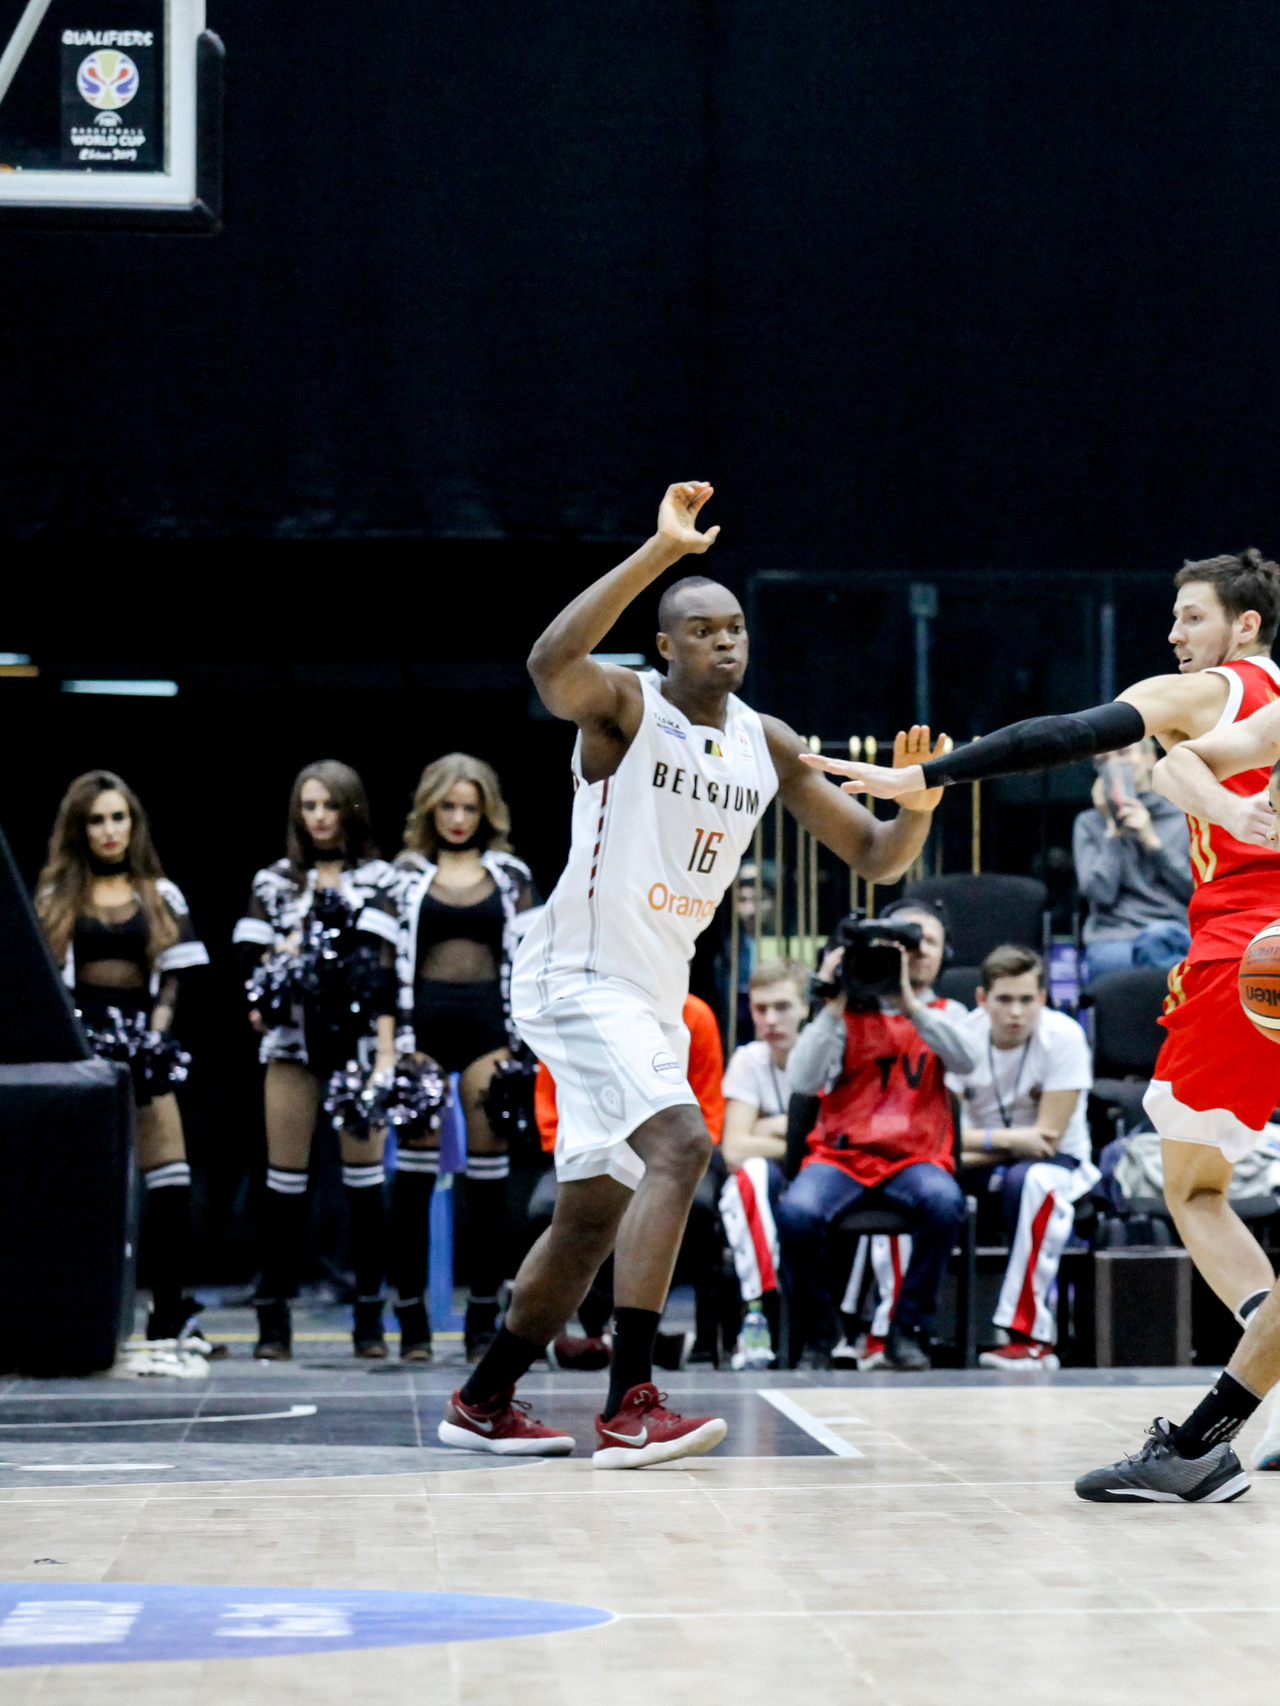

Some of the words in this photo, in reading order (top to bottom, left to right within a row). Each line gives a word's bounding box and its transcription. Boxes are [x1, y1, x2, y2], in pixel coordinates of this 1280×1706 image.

[62, 30, 153, 46] QUALIFIERS
[71, 135, 117, 146] WORLD
[119, 135, 146, 146] CUP
[653, 762, 759, 815] BELGIUM
[687, 828, 724, 873] 16
[648, 883, 717, 923] Orang
[875, 1053, 927, 1091] TV
